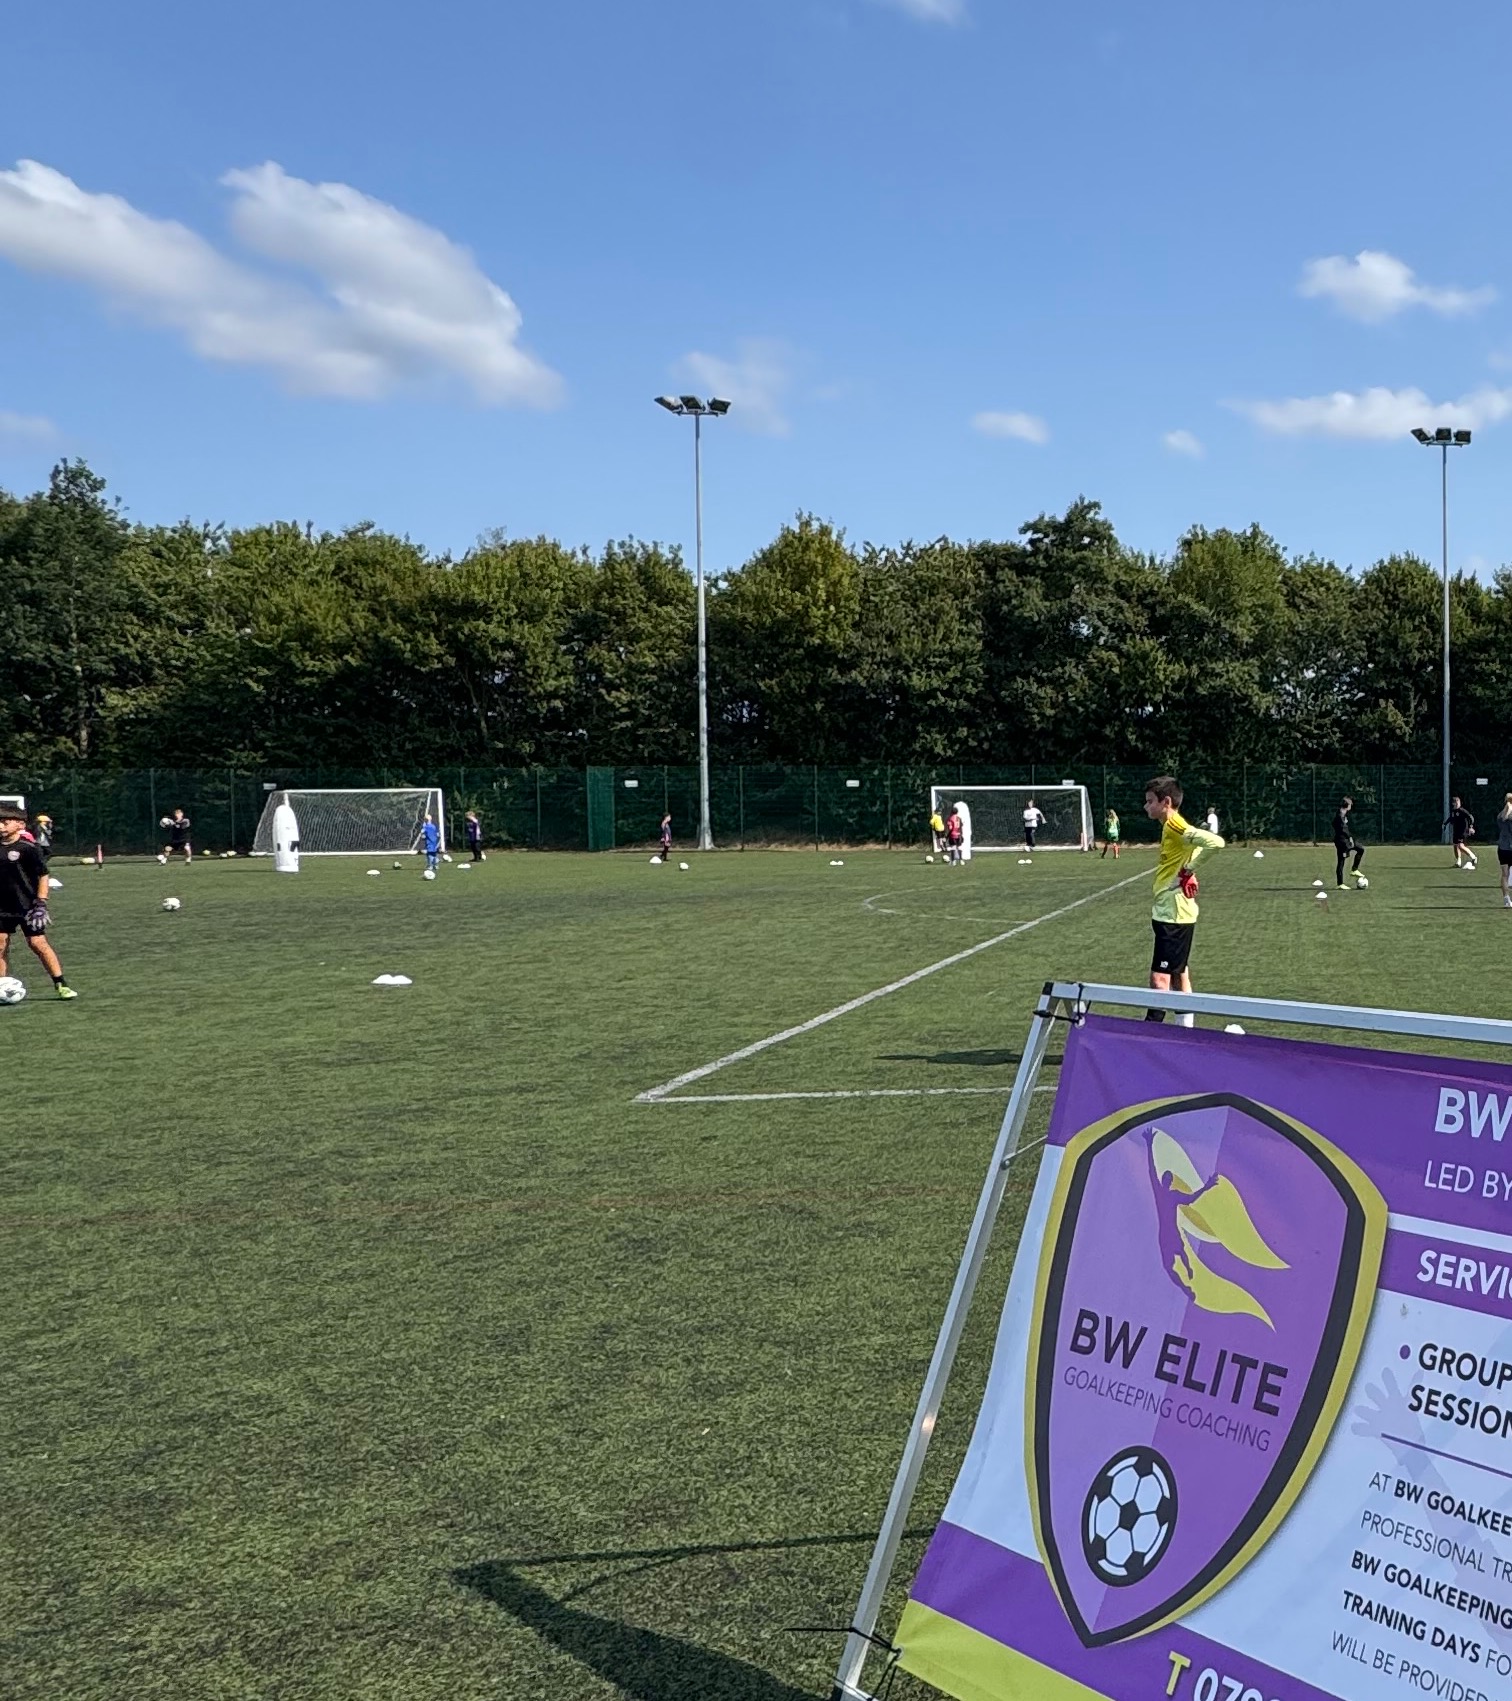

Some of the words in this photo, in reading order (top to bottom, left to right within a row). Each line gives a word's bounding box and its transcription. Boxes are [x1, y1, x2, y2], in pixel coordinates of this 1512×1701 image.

[1423, 1160, 1475, 1196] LED
[1069, 1308, 1148, 1370] BW
[1155, 1332, 1288, 1417] ELITE
[1063, 1366, 1174, 1419] GOALKEEPING
[1176, 1404, 1271, 1452] COACHING
[1369, 1472, 1391, 1492] AT
[1394, 1479, 1424, 1503] BW
[1351, 1550, 1380, 1577] BW
[1360, 1510, 1485, 1572] PROFESSIONAL
[1342, 1590, 1426, 1642] TRAINING
[1430, 1627, 1480, 1664] DAYS
[1167, 1650, 1192, 1696] T
[1331, 1630, 1368, 1665] WILL
[1372, 1648, 1396, 1675] BE
